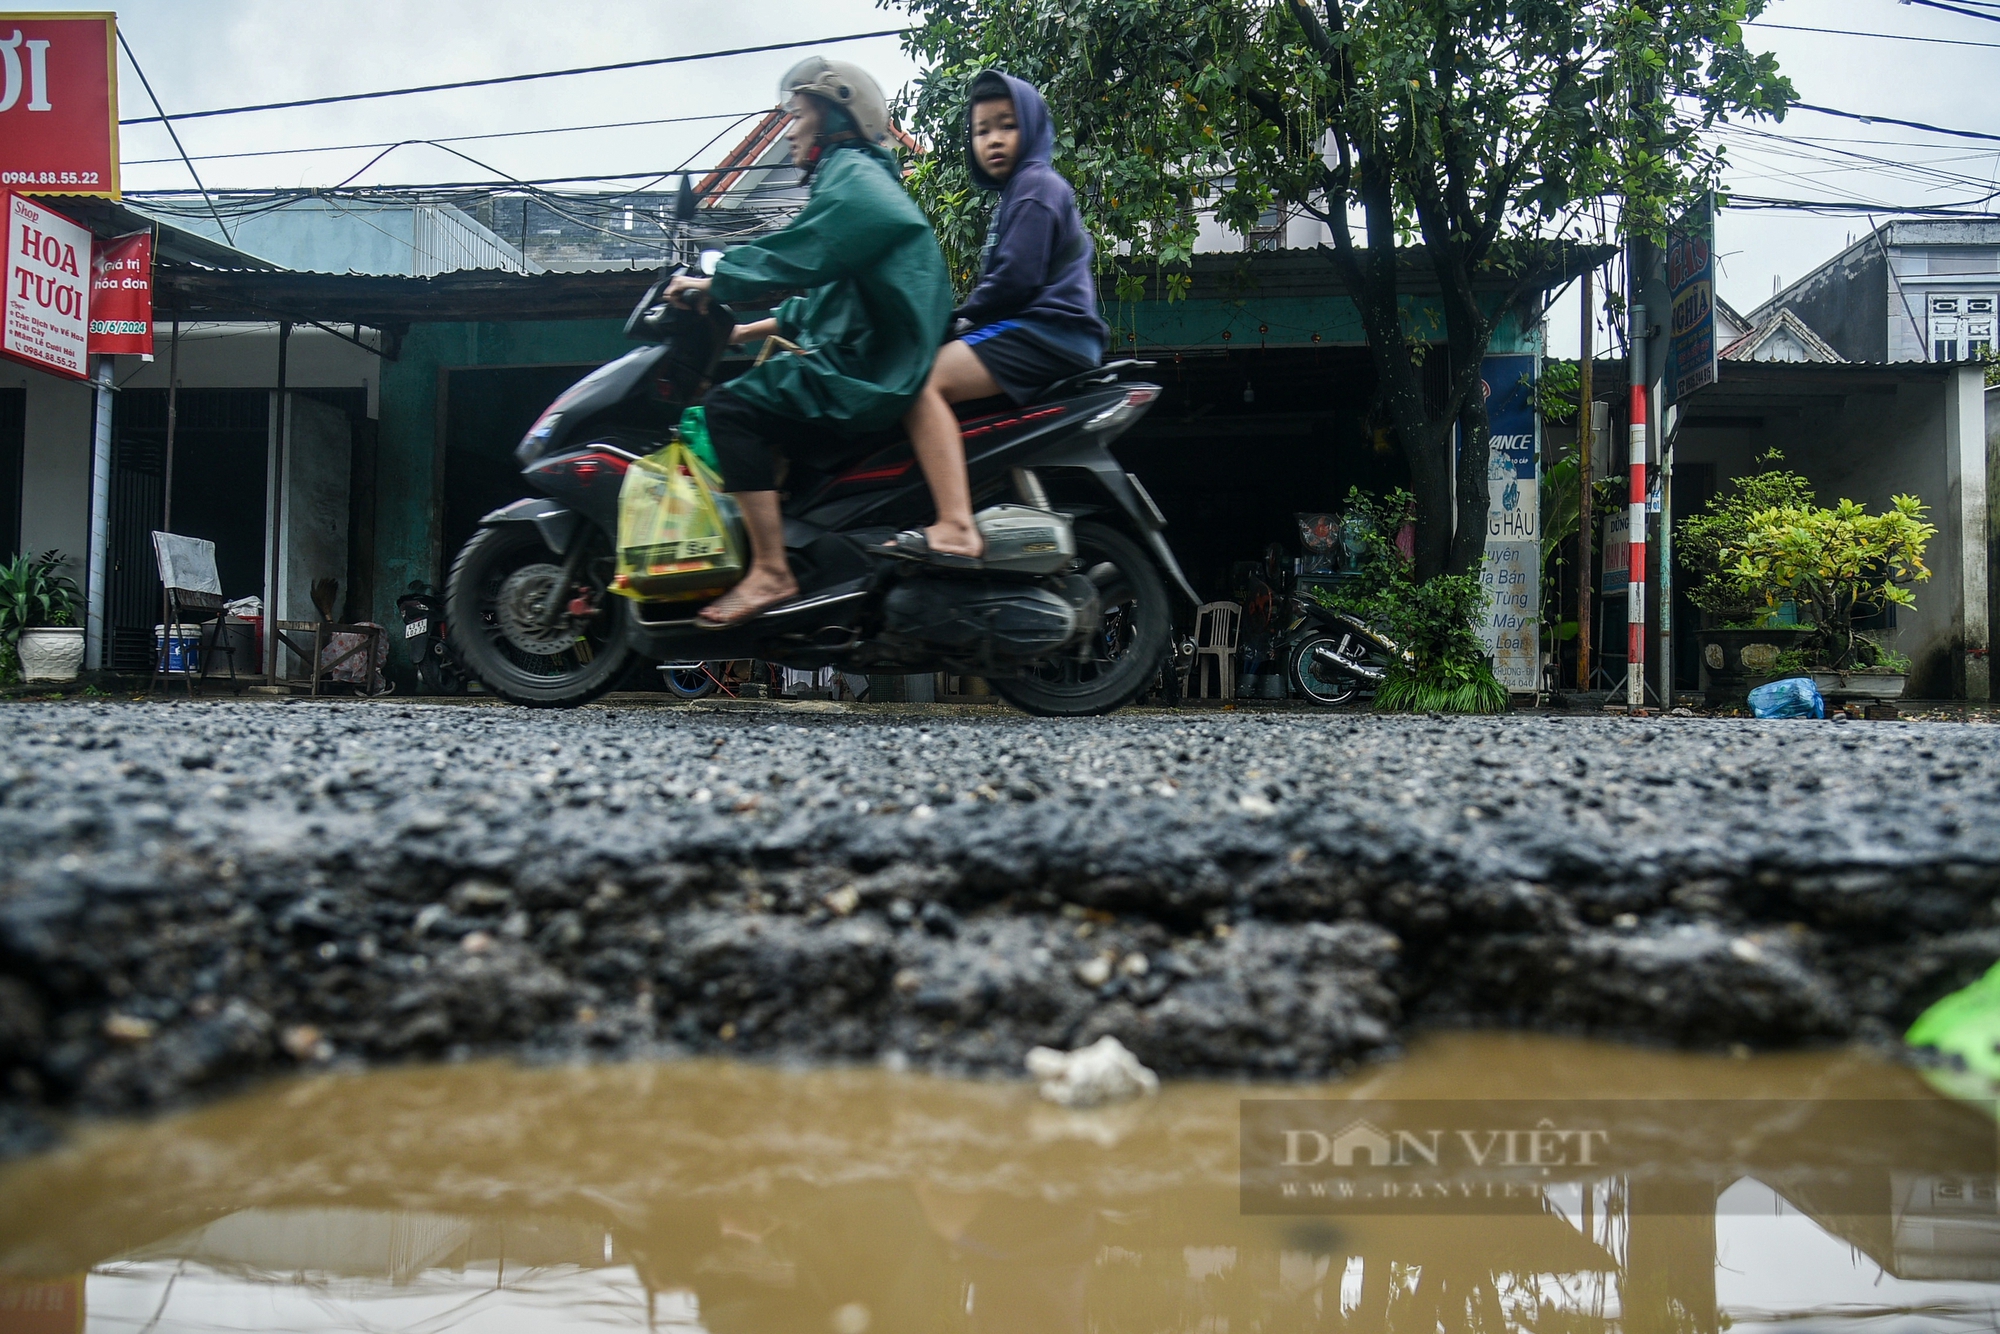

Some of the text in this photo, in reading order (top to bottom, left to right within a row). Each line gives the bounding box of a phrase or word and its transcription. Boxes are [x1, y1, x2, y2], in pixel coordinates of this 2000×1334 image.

[2, 171, 99, 184] 0984.88.55.22
[15, 201, 40, 223] Shop
[21, 224, 80, 278] HOA
[126, 258, 141, 273] trị
[1670, 235, 1709, 292] GAS
[15, 266, 83, 321] TƯƠI
[121, 277, 148, 290] đơn
[31, 317, 49, 328] Dịch
[70, 331, 85, 343] Hoa
[90, 320, 147, 335] 30/6/2024
[23, 344, 78, 370] 0984.88.55.22
[1503, 508, 1534, 539] HẬU
[1498, 569, 1526, 585] Bán
[1495, 591, 1529, 608] Tùng
[1493, 613, 1526, 632] Máy
